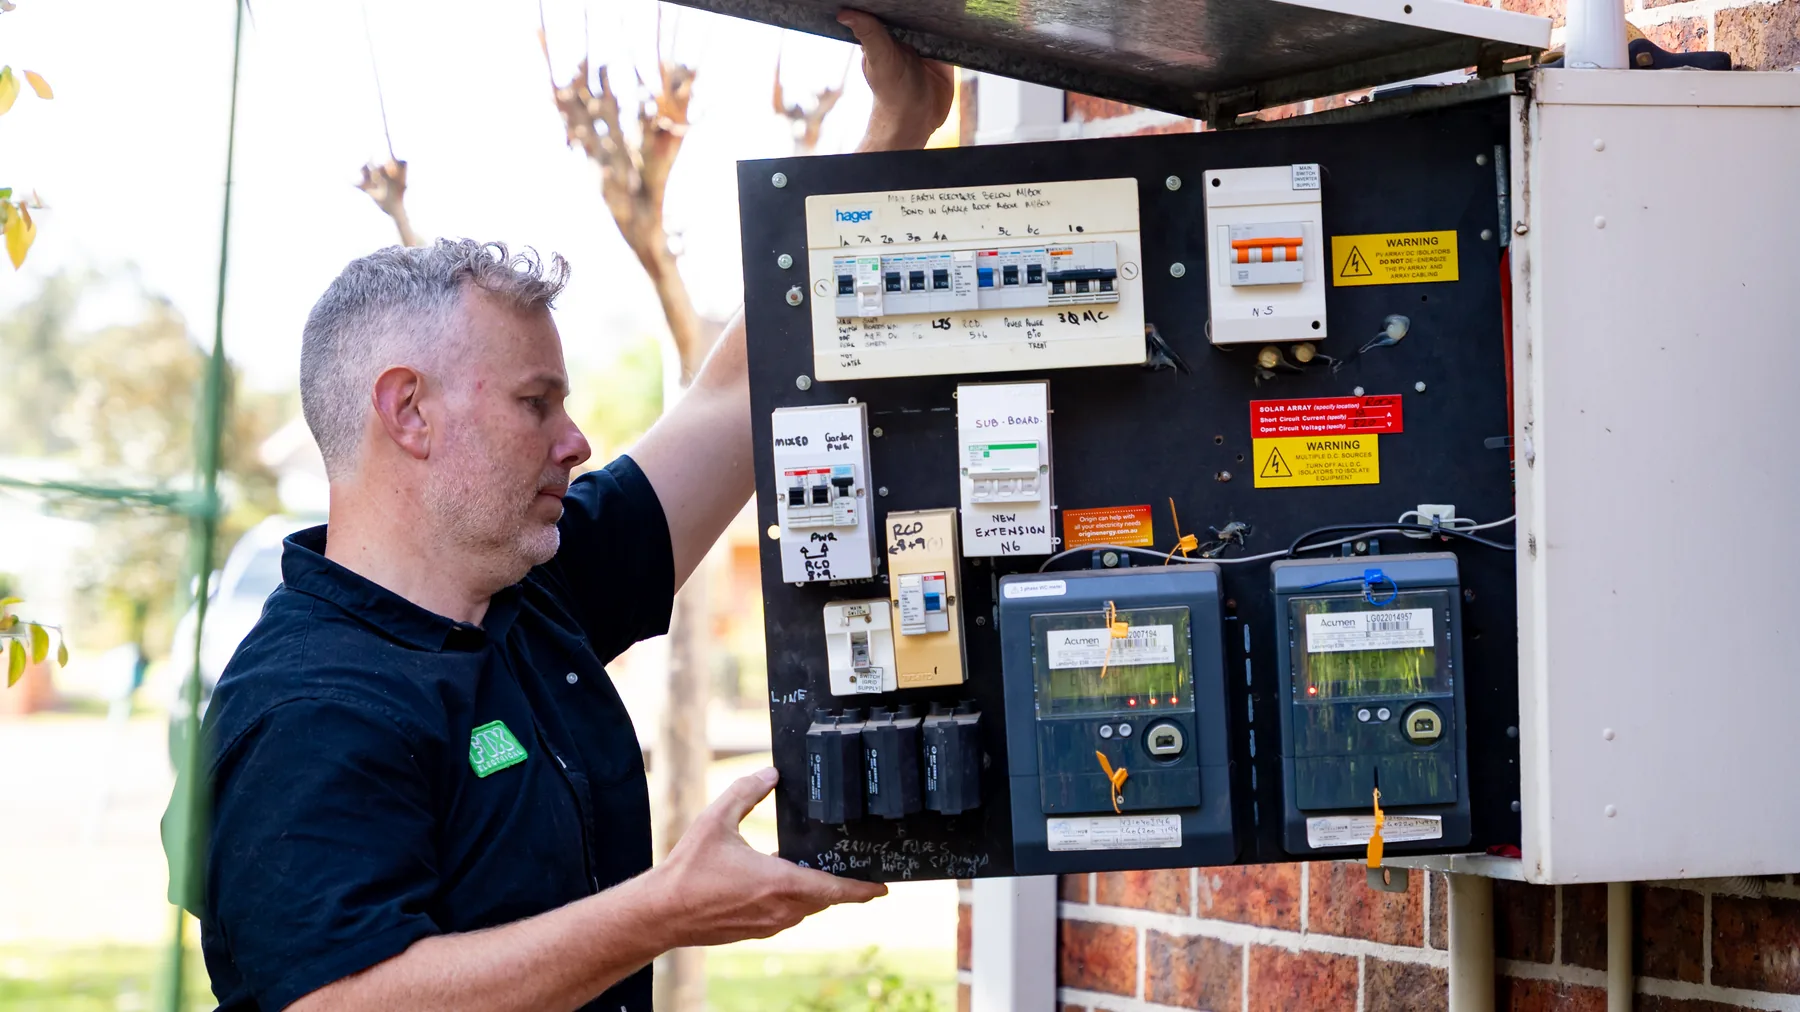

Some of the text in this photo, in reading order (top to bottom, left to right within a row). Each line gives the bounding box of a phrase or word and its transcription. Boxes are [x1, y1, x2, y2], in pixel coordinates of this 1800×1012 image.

[836, 209, 873, 223] hager
[857, 235, 872, 243] 7A
[1386, 236, 1439, 247] WARNING
[1326, 413, 1347, 421] (specify)
[775, 436, 809, 447] MIXED
[825, 432, 854, 442] Garden
[827, 443, 850, 452] PWR
[1306, 440, 1361, 451] WARNING
[992, 513, 1016, 523] NEW
[1109, 514, 1122, 522] help
[892, 521, 923, 540] RCD
[975, 526, 1045, 537] EXTENSION
[1078, 528, 1138, 537] originenergy.com.au
[810, 532, 837, 542] PWR
[1000, 541, 1021, 554] N6
[805, 560, 830, 572] RCD
[1366, 612, 1413, 622] LG022014957
[1320, 618, 1355, 627] Acumen
[1064, 637, 1100, 645] Acumen
[477, 749, 524, 772] ELECTRICAL
[834, 839, 890, 854] SERVICE
